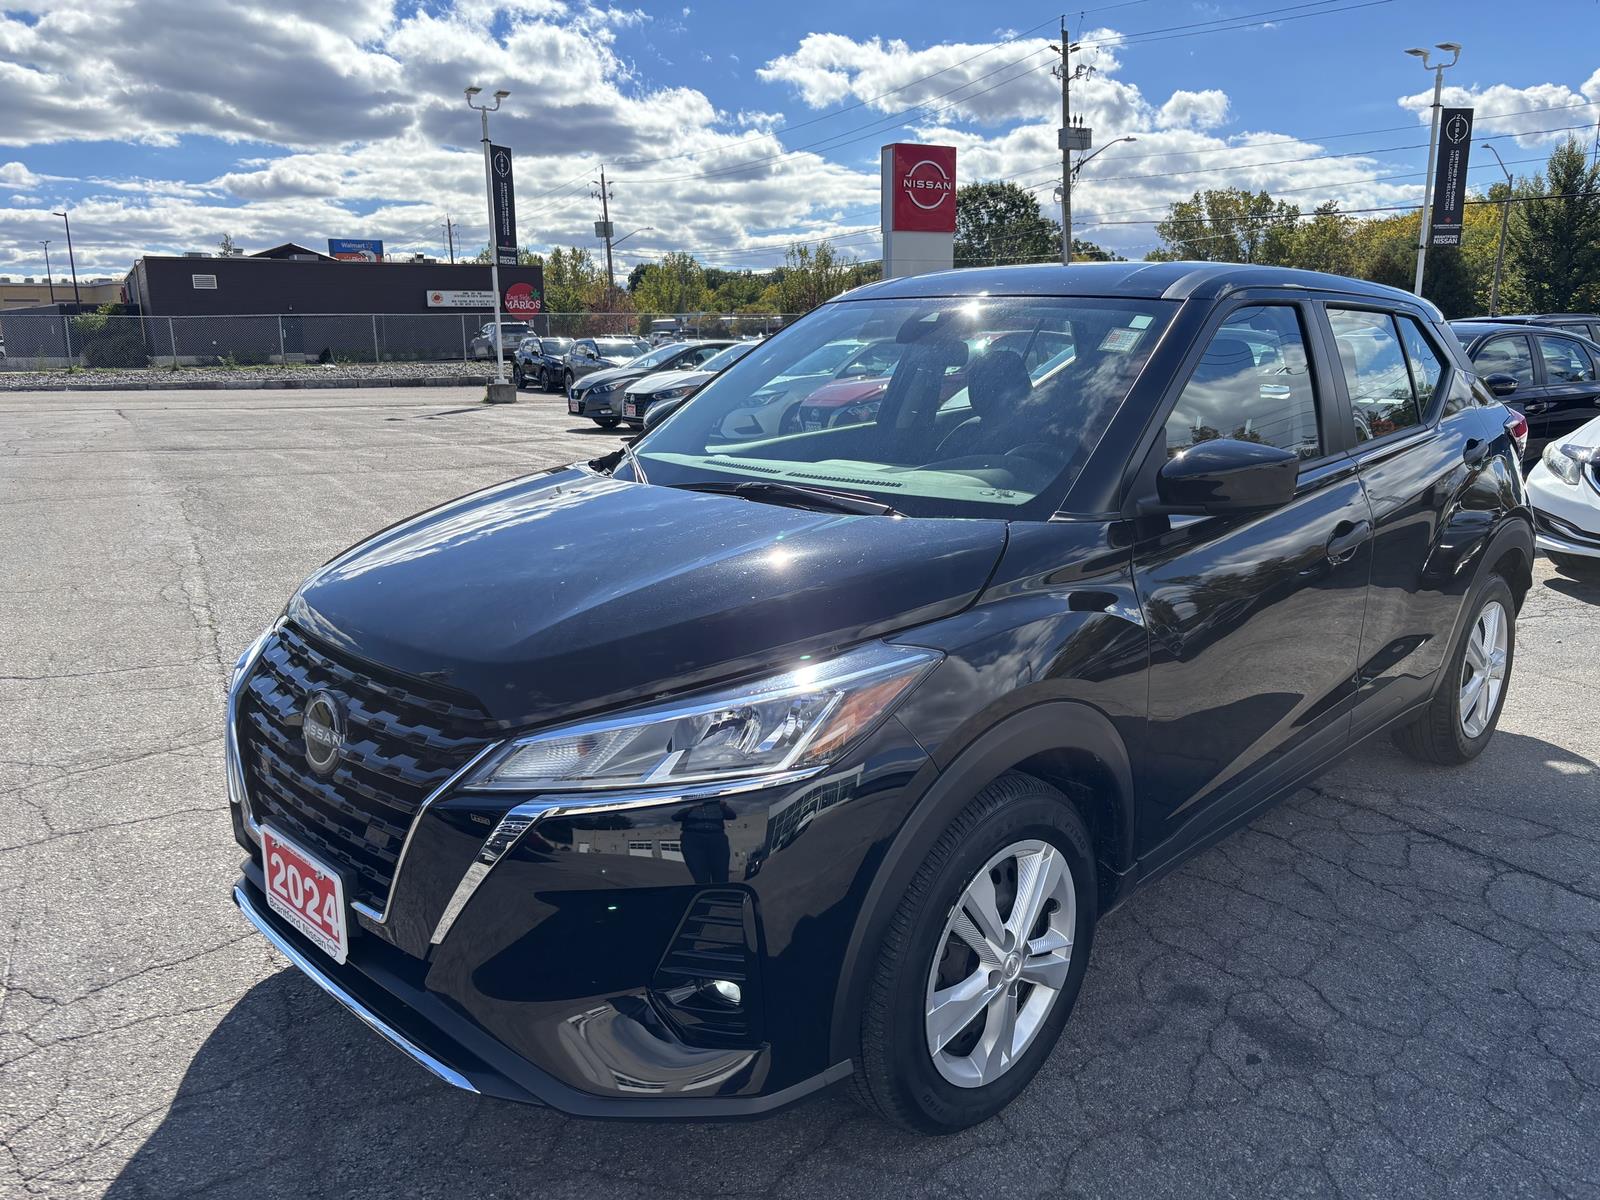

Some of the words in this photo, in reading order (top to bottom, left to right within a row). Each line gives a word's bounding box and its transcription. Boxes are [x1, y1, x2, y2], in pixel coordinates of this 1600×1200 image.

[1453, 113, 1461, 144] NISSAN
[903, 179, 952, 190] NISSAN
[270, 852, 340, 940] 2024
[269, 896, 301, 929] Brantford
[302, 923, 327, 949] Nissan
